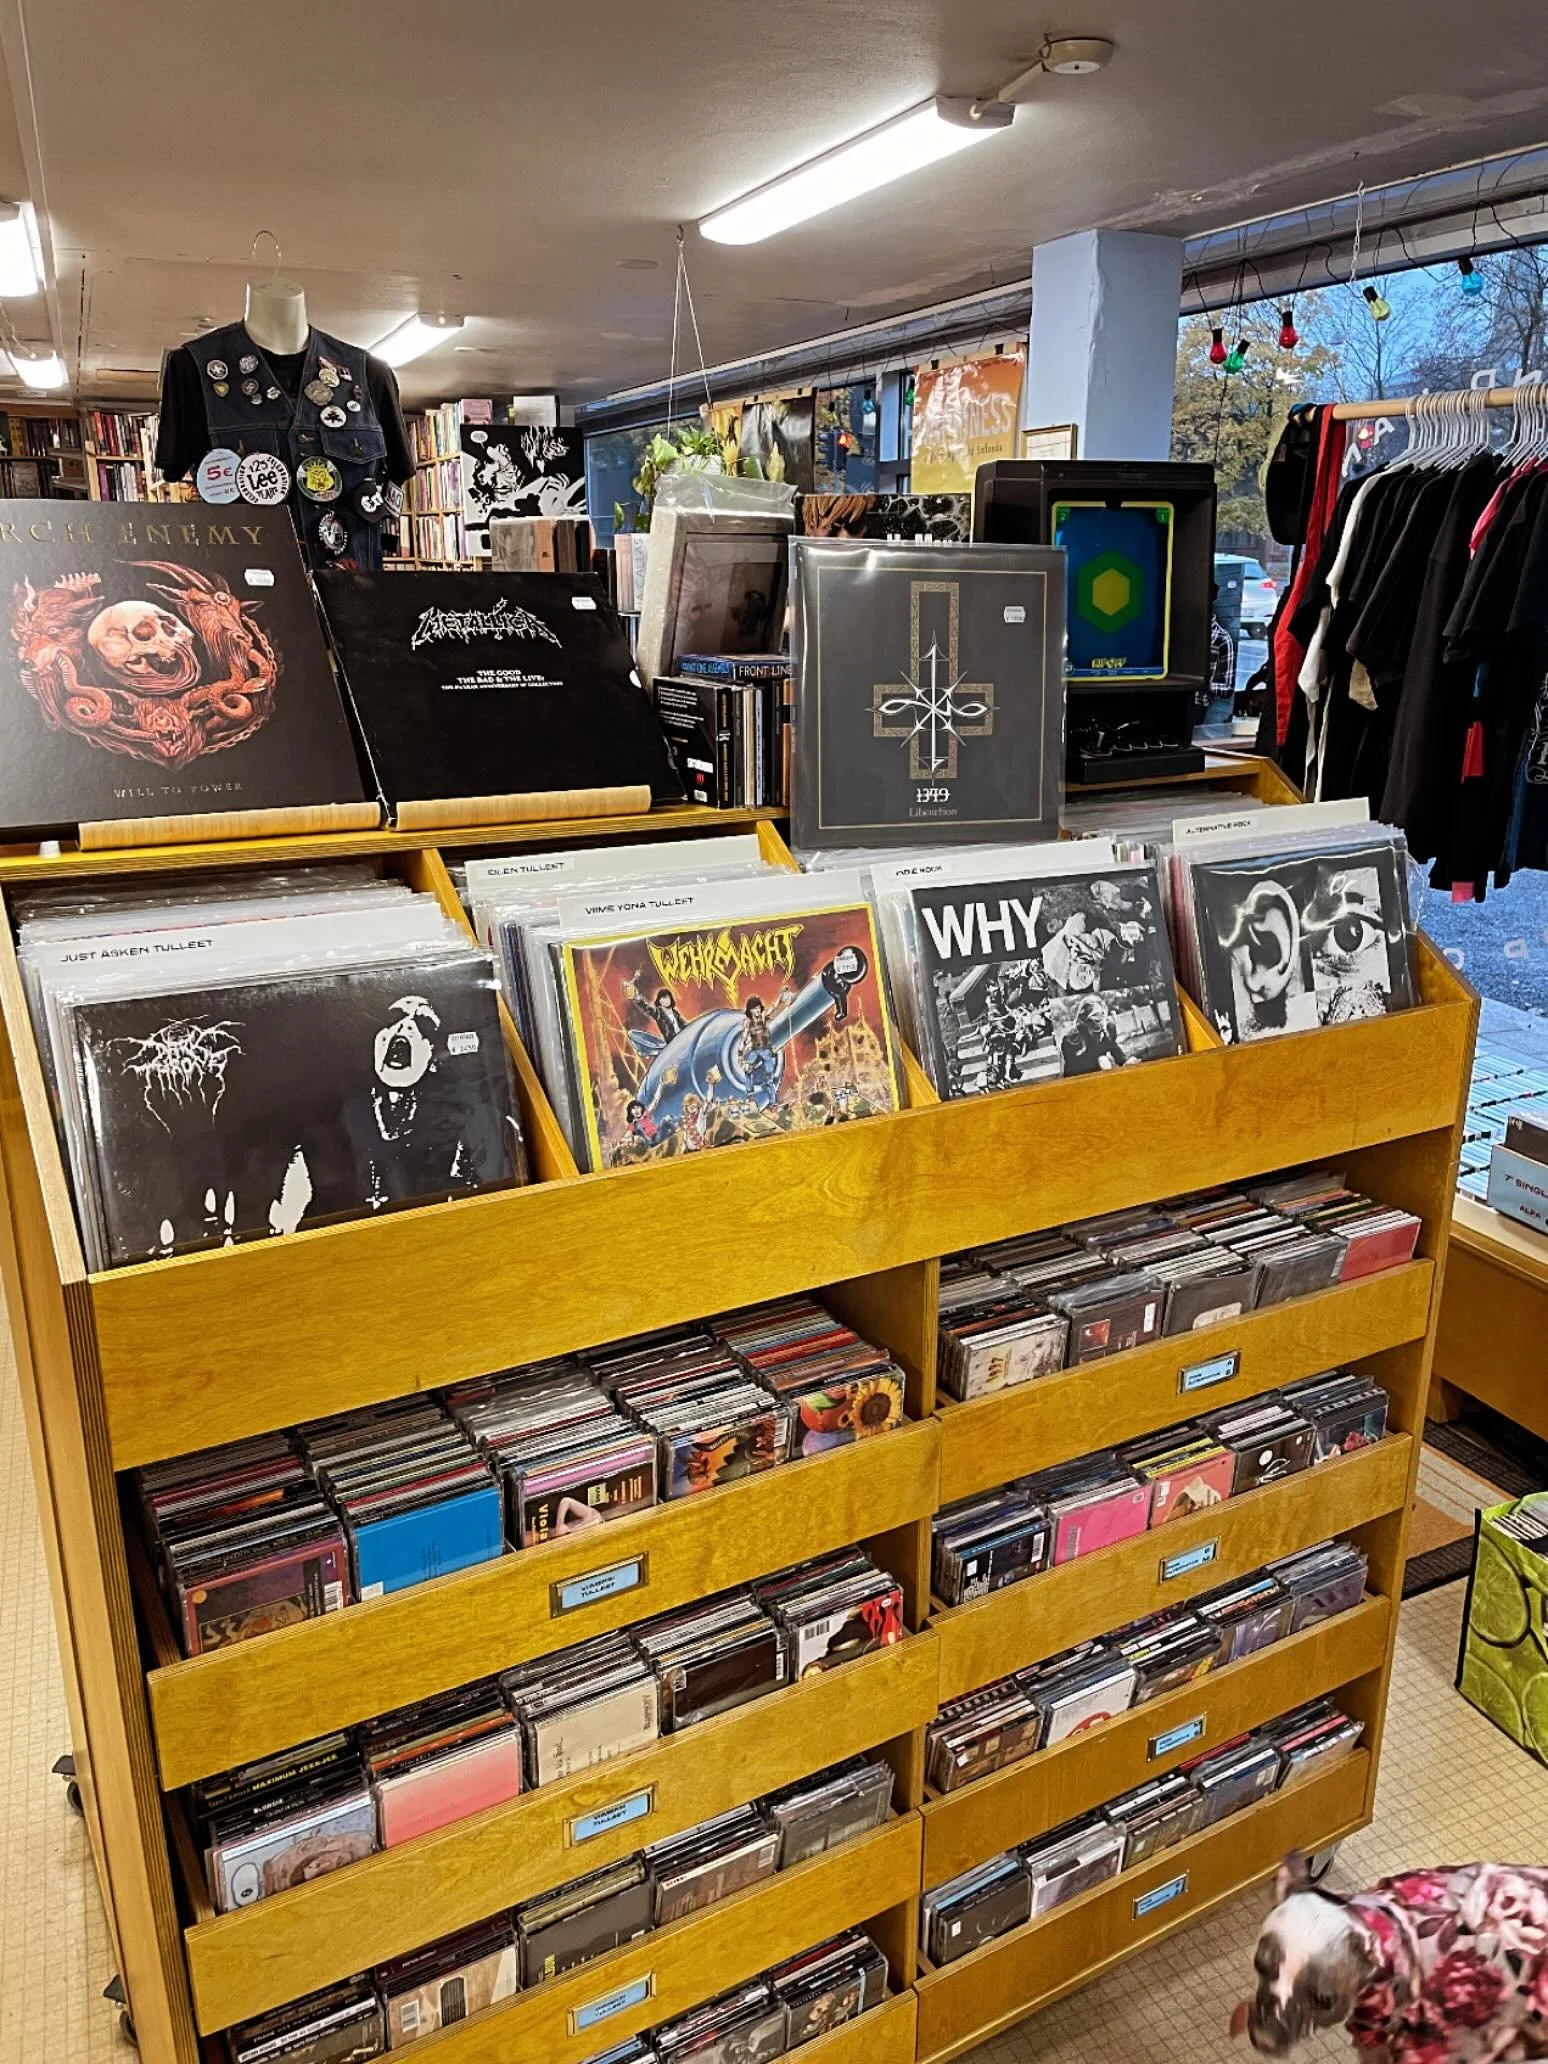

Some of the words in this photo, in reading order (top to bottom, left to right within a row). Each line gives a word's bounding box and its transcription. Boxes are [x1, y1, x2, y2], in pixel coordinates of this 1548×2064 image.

[247, 470, 278, 490] Lee
[118, 520, 265, 546] ENEMY
[410, 596, 563, 651] METALLICA
[456, 676, 476, 684] THE
[476, 676, 495, 684] BAD
[503, 674, 522, 682] THE
[738, 664, 769, 678] FRONT
[112, 787, 154, 799] WILL
[160, 786, 181, 796] TO
[190, 782, 242, 794] POWER
[916, 787, 951, 803] 1349
[908, 807, 958, 817] Liberation
[921, 896, 1044, 960] WHY
[60, 951, 97, 963] JUST
[153, 940, 214, 952] TULLEET
[646, 934, 805, 1008] WEHRMACHT
[252, 1768, 298, 1791] MAXIMUM
